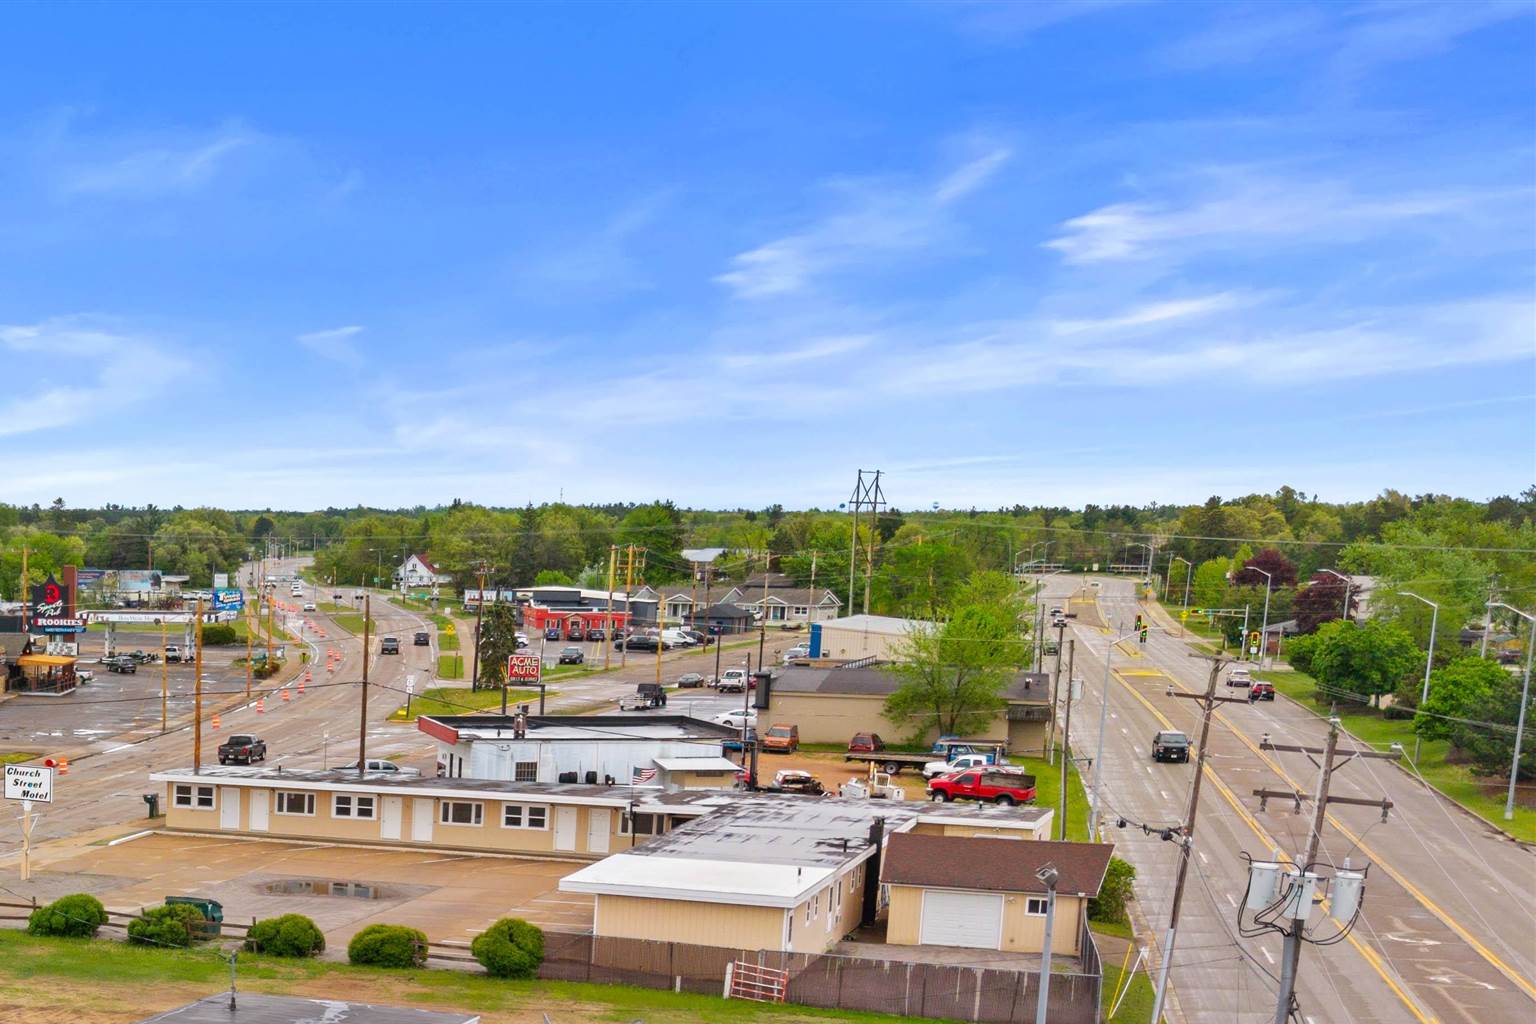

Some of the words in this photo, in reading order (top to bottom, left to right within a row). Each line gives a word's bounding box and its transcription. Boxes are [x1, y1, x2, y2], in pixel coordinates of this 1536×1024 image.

[37, 618, 84, 626] ROOKIES
[511, 656, 539, 666] ACME
[512, 665, 538, 675] AUTO
[7, 767, 41, 778] Church
[13, 778, 43, 789] Street
[21, 789, 48, 800] Motel
